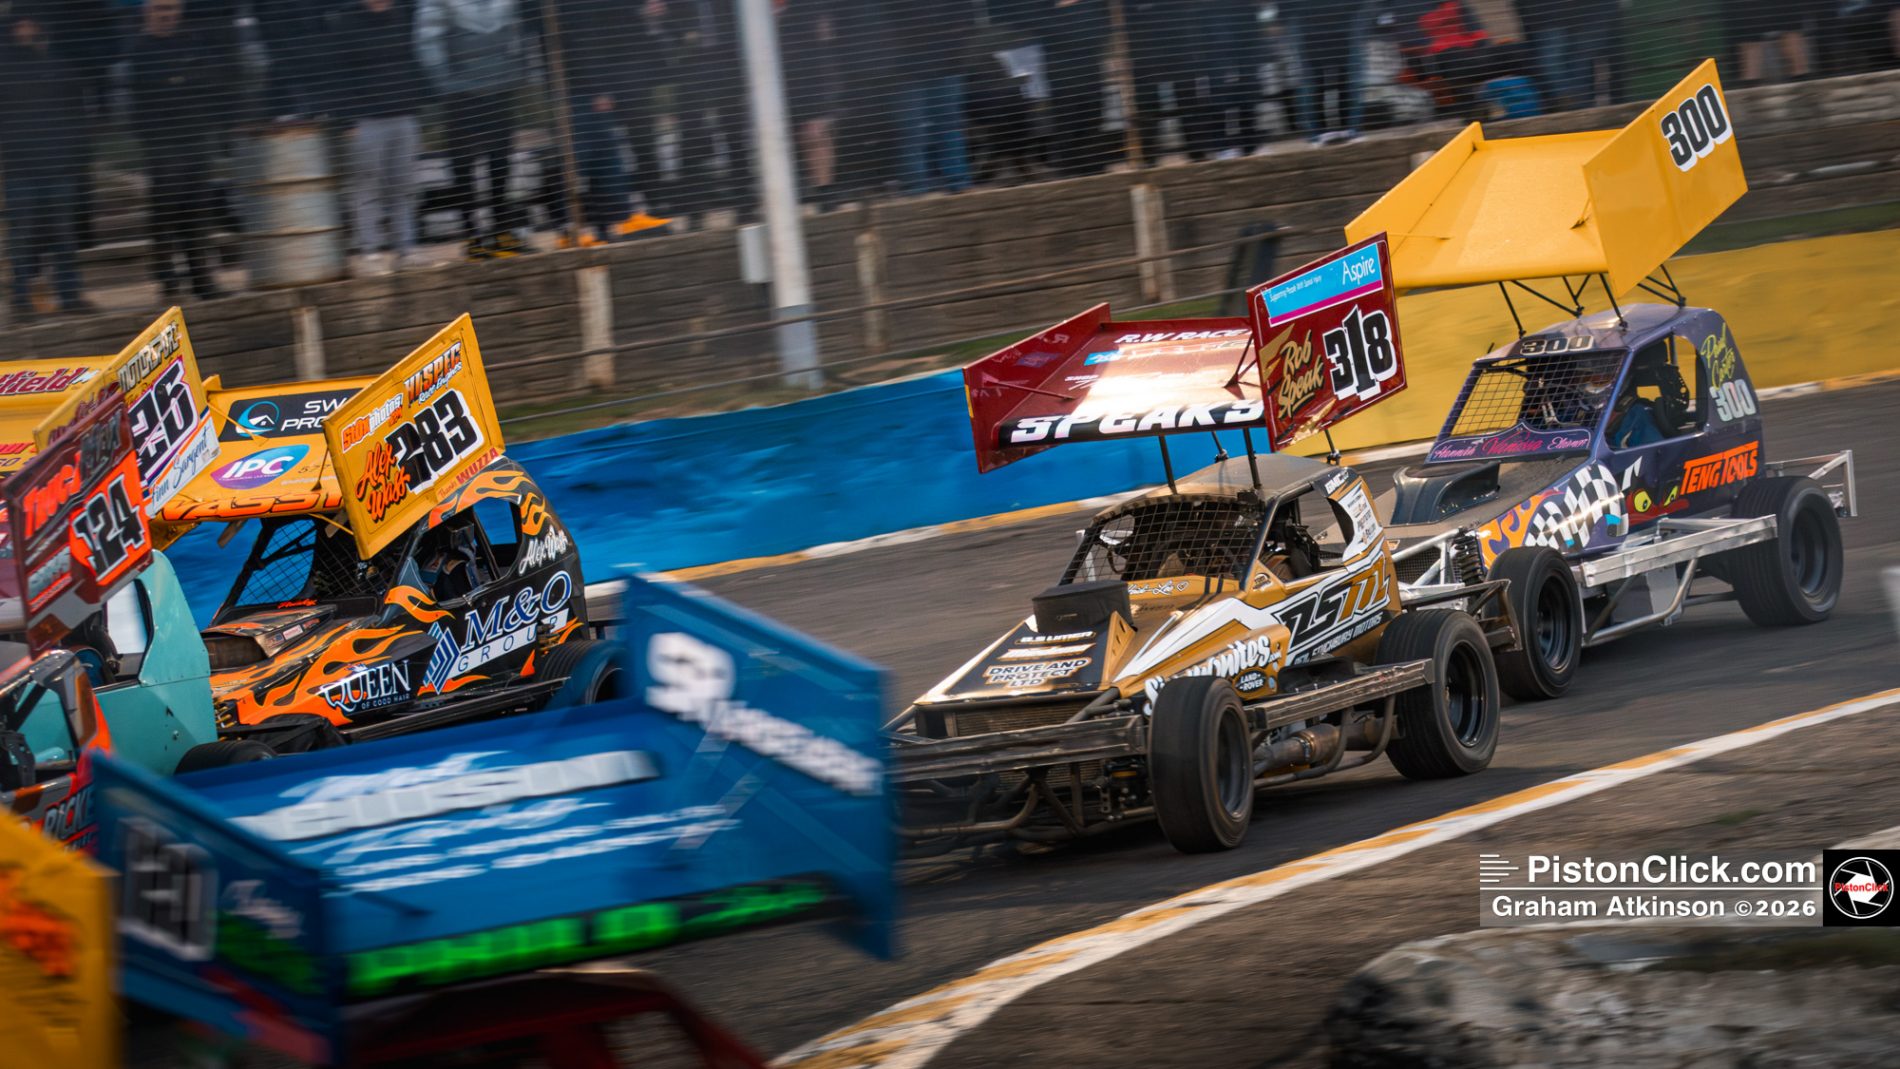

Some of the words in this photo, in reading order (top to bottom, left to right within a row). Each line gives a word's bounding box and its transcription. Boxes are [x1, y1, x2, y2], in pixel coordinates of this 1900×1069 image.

[1661, 83, 1733, 172] 300
[1342, 255, 1376, 285] Aspire
[1279, 329, 1313, 377] Rob
[1322, 304, 1398, 401] 318
[1519, 335, 1595, 356] 300
[1277, 354, 1325, 419] Speak
[1709, 378, 1758, 422] 300
[127, 354, 199, 483] 26
[384, 388, 485, 495] 283
[221, 455, 295, 479] IPC
[356, 442, 397, 499] Alex
[456, 447, 499, 486] WUZZA
[1680, 453, 1723, 496] TENG
[1720, 440, 1760, 485] TOOLS
[368, 465, 411, 523] Wass
[71, 473, 145, 582] 124
[517, 537, 547, 576] Alex
[461, 569, 573, 651] M&O
[319, 659, 412, 713] QUEEN
[988, 663, 1045, 676] DRIVE
[1047, 658, 1088, 671] AND
[991, 668, 1074, 683] PROTECT
[1009, 678, 1044, 688] LTD
